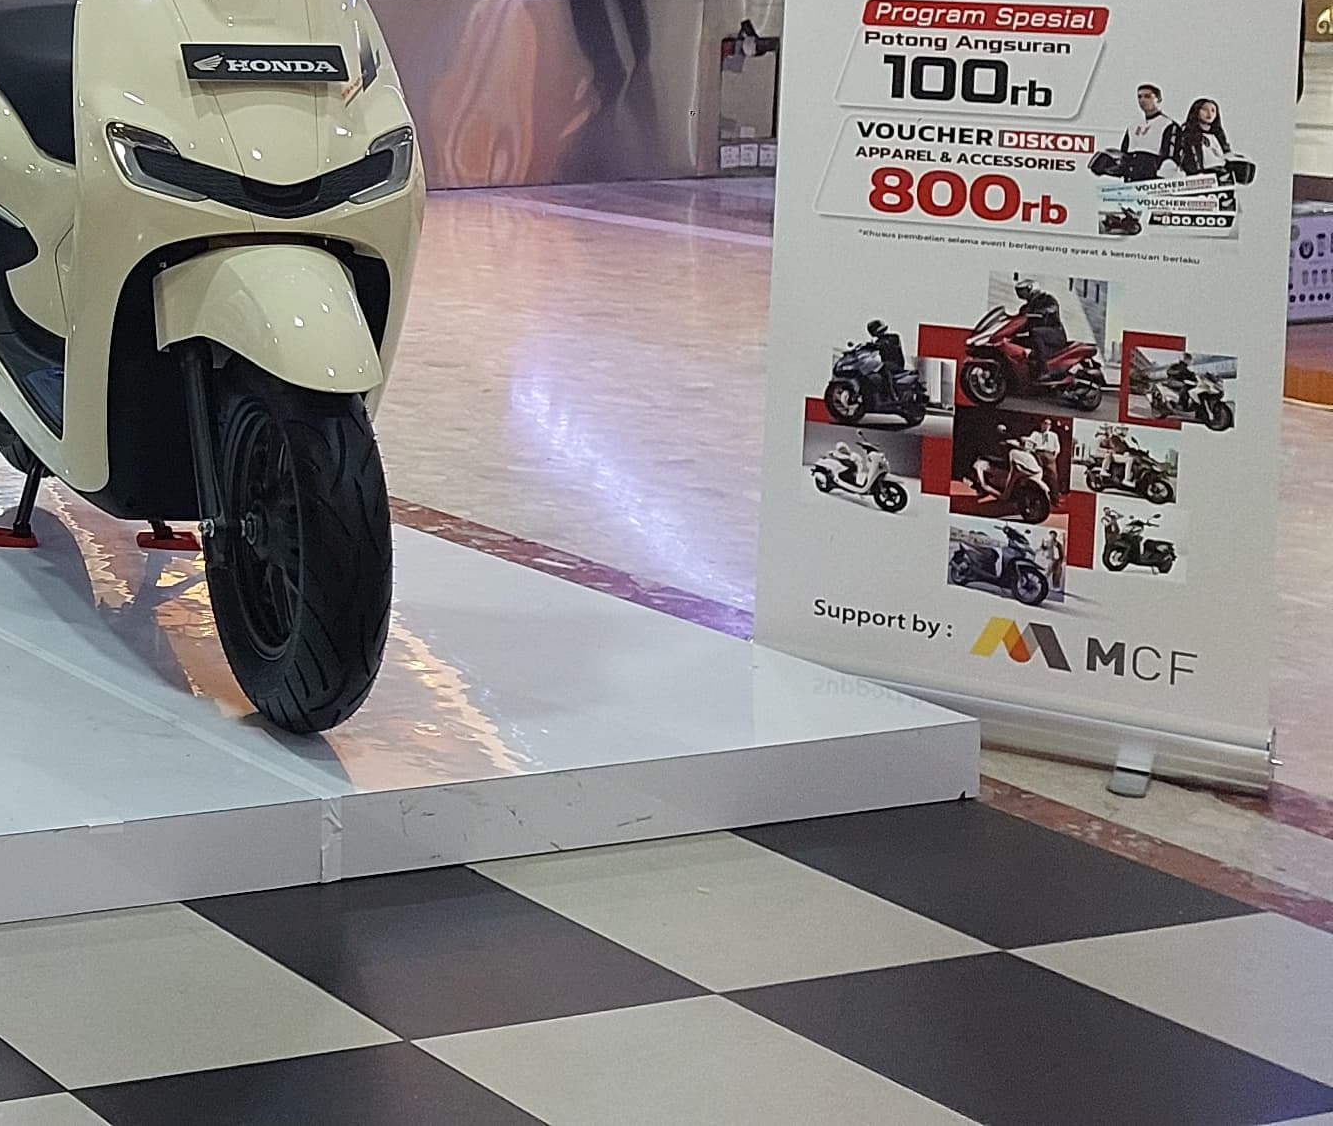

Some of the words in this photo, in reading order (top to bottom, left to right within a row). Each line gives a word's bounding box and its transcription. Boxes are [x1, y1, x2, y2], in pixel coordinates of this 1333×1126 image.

[874, 1, 986, 27] Program
[994, 7, 1095, 32] Spesial
[864, 30, 948, 52] Potong
[954, 35, 1072, 55] Angsuran
[225, 58, 340, 74] HONDA
[882, 54, 1053, 108] 100rb
[856, 120, 994, 148] VOUCHER
[1003, 131, 1091, 153] DISKON
[855, 145, 937, 164] APPAREL
[939, 150, 953, 164] &
[956, 152, 1077, 172] ACCESSORIES
[868, 166, 1069, 227] 800rb
[1135, 180, 1186, 193] VOUCHER
[1136, 198, 1187, 208] VOUCHER
[813, 597, 909, 632] Support
[911, 614, 941, 639] by
[1085, 636, 1199, 687] MCF
